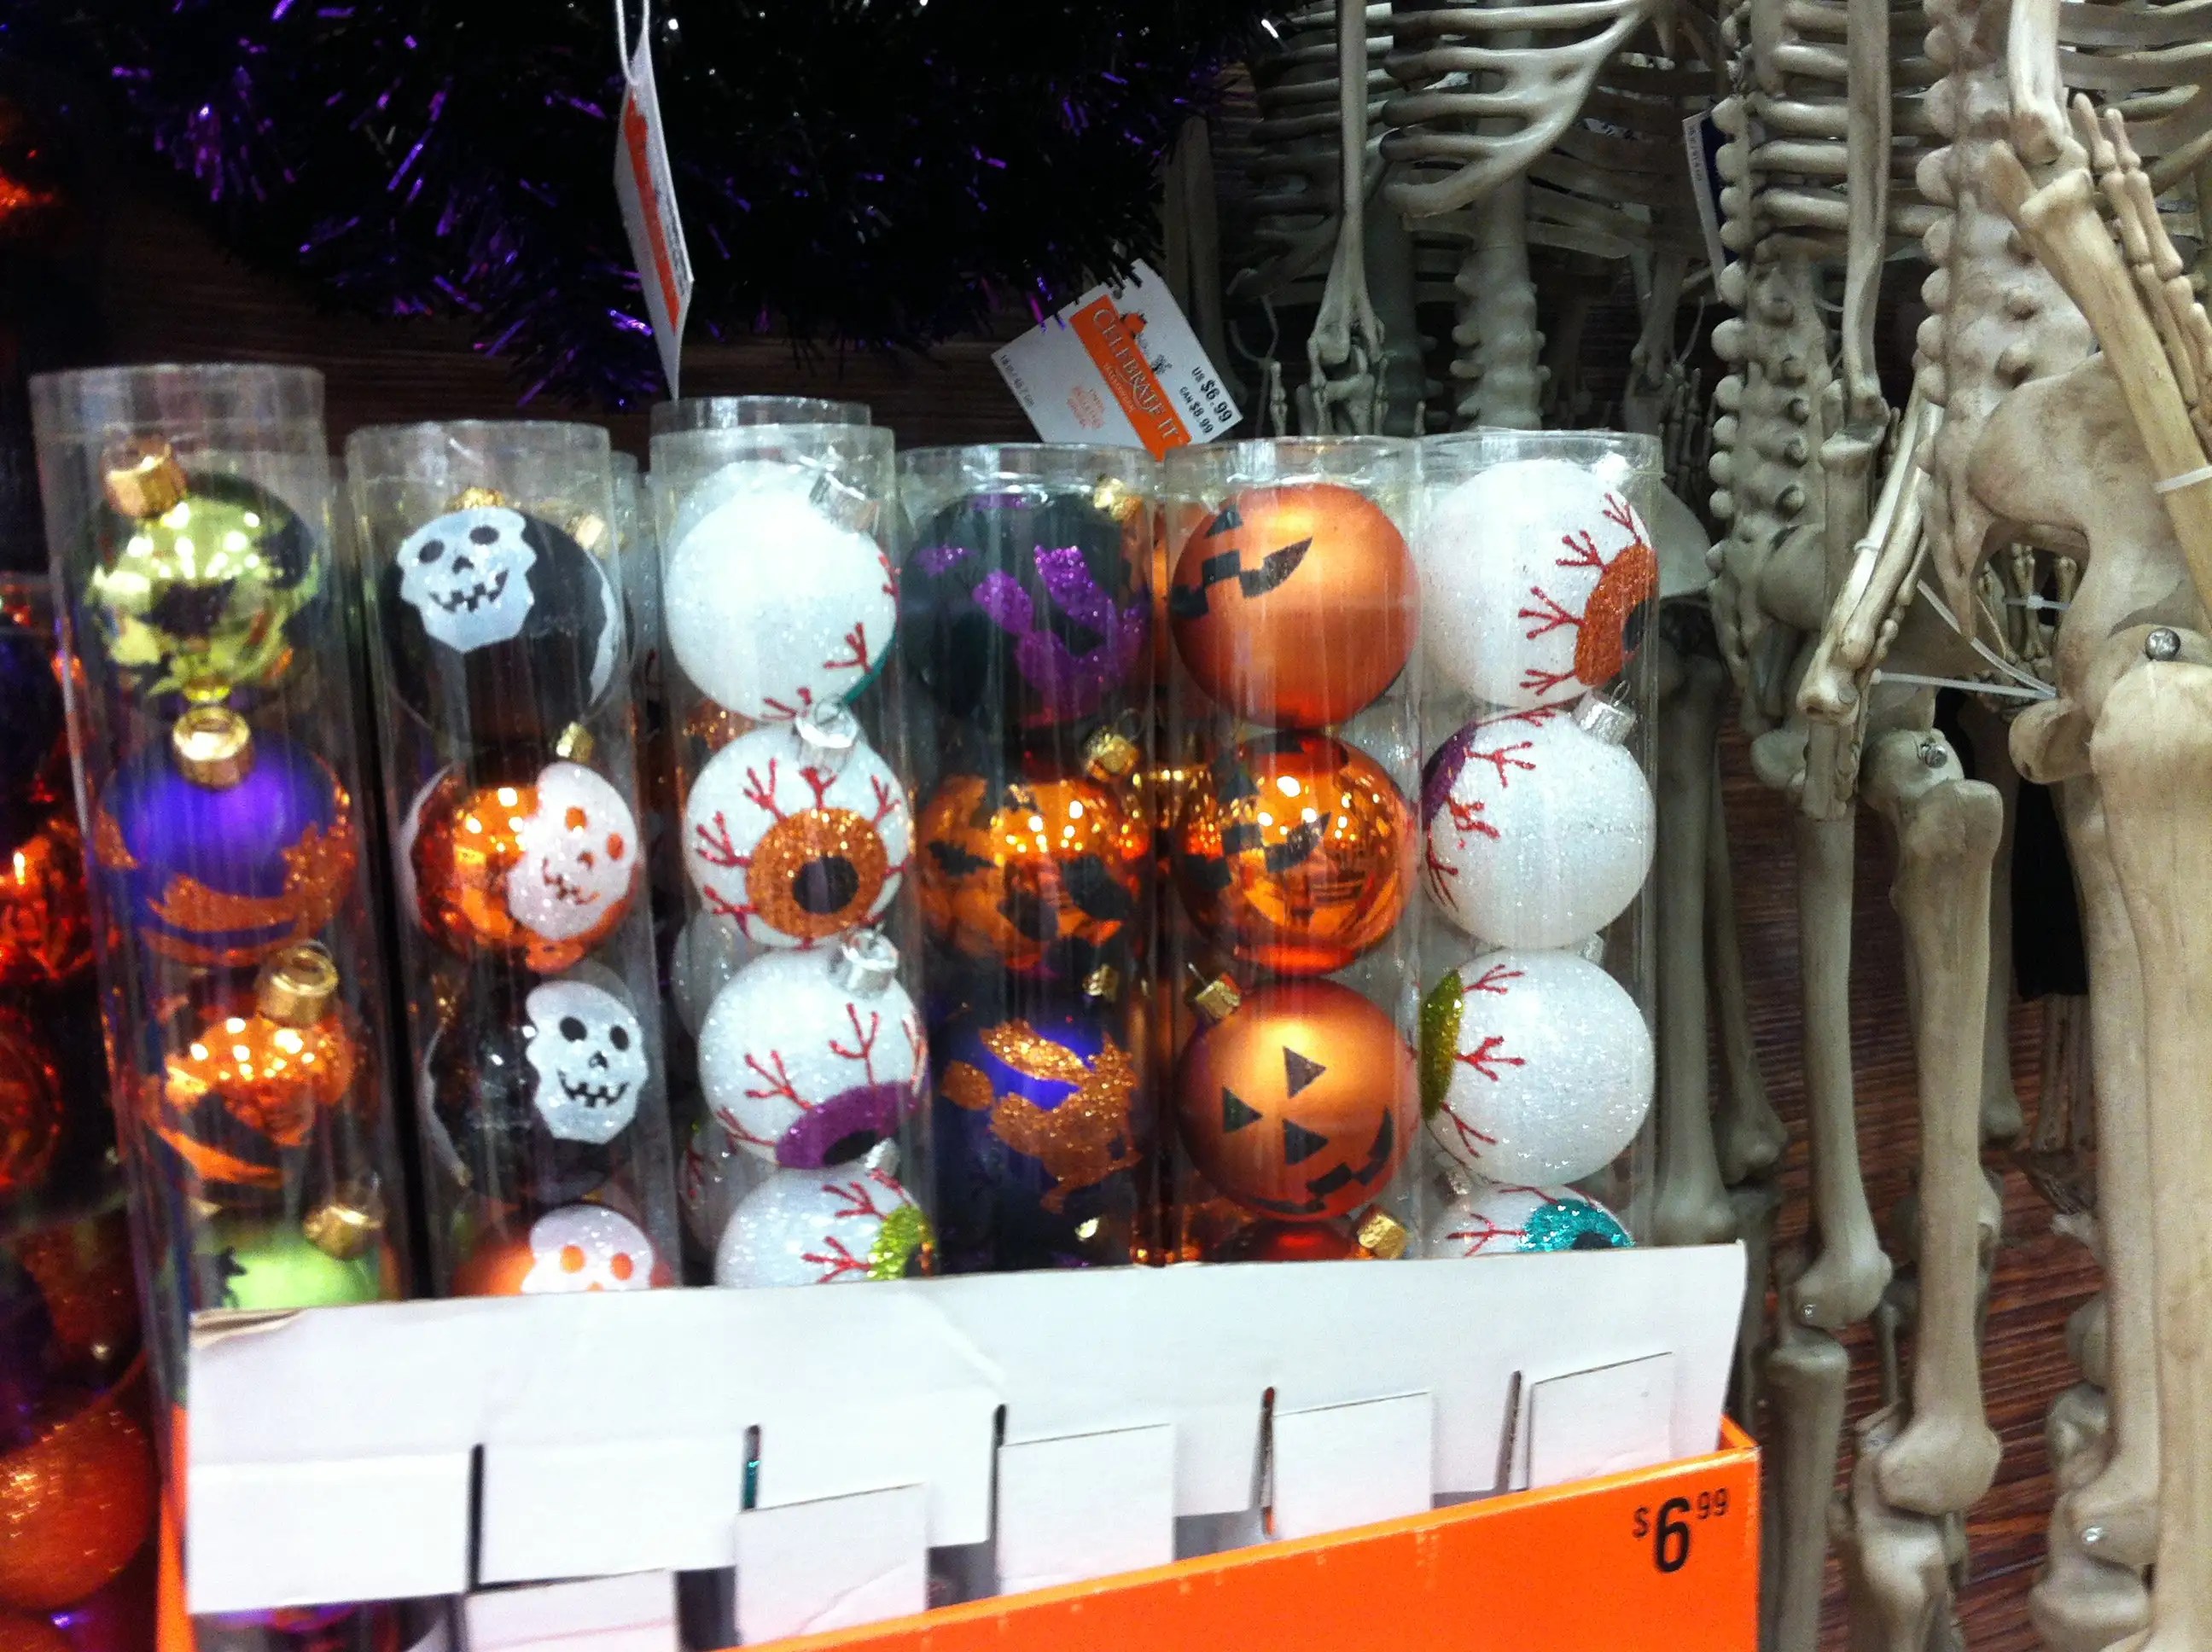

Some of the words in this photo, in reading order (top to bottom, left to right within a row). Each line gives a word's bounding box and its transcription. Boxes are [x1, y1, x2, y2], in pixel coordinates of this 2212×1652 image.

[1092, 308, 1166, 416] CELEBRATE
[1157, 417, 1179, 439] IT
[1191, 366, 1206, 382] US
[1200, 379, 1232, 423] $6.99
[1179, 386, 1193, 404] CAN
[1188, 400, 1214, 433] $8.99
